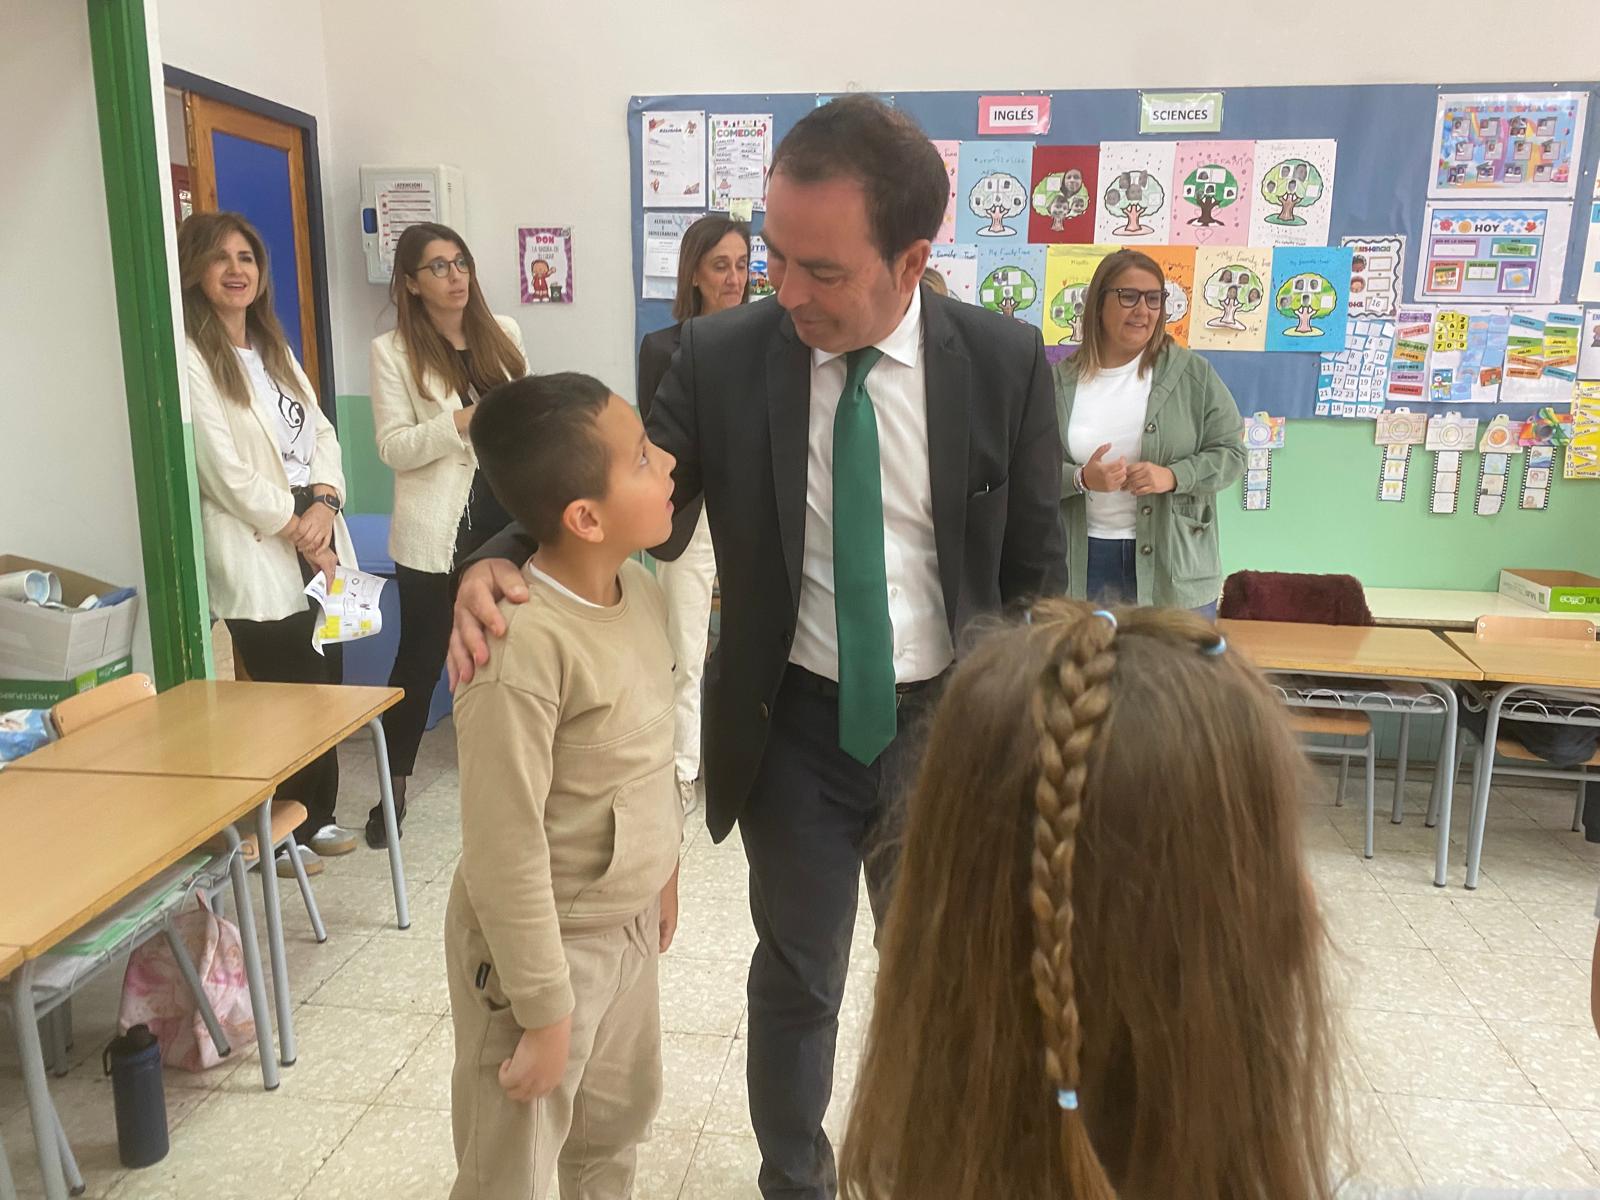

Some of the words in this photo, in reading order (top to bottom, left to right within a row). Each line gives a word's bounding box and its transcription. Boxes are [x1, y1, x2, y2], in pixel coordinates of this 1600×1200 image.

[993, 107, 1034, 121] INGLÉS
[1153, 109, 1208, 121] SCIENCES
[716, 129, 763, 138] COMEDOR
[1474, 224, 1500, 232] HOY
[1372, 299, 1381, 308] 16
[1373, 378, 1382, 386] 20
